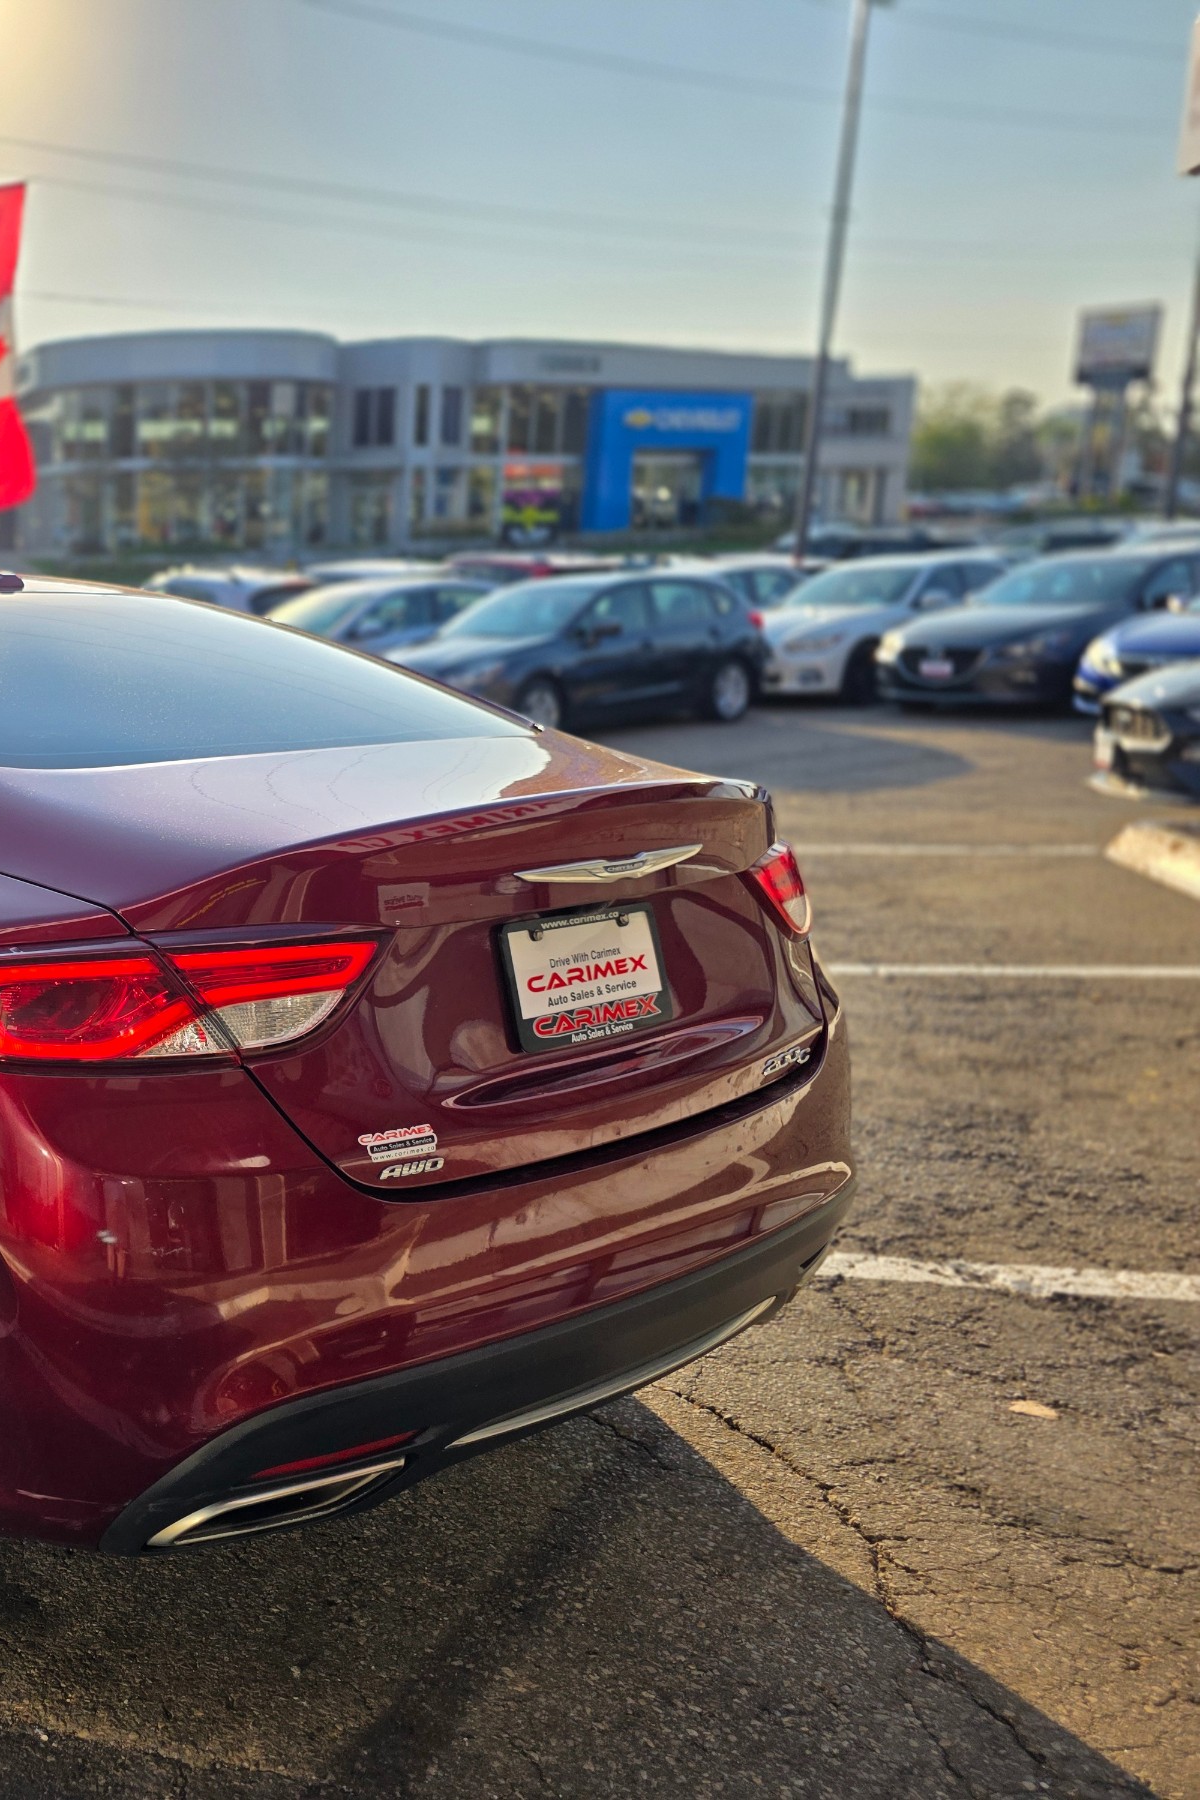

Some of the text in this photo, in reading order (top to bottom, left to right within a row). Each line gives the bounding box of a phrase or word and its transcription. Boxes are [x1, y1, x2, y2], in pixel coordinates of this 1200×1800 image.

[541, 912, 619, 929] www.carimex.ca
[549, 947, 621, 968] Drive With Carimex
[527, 954, 648, 993] CARIMEX
[548, 980, 637, 1008] Auto Sales & Service
[533, 993, 661, 1038] CARIMEX
[571, 1022, 633, 1043] Auto Sales & Service
[388, 1142, 405, 1150] Sales
[411, 1137, 432, 1145] Service
[380, 1158, 444, 1180] AWD
